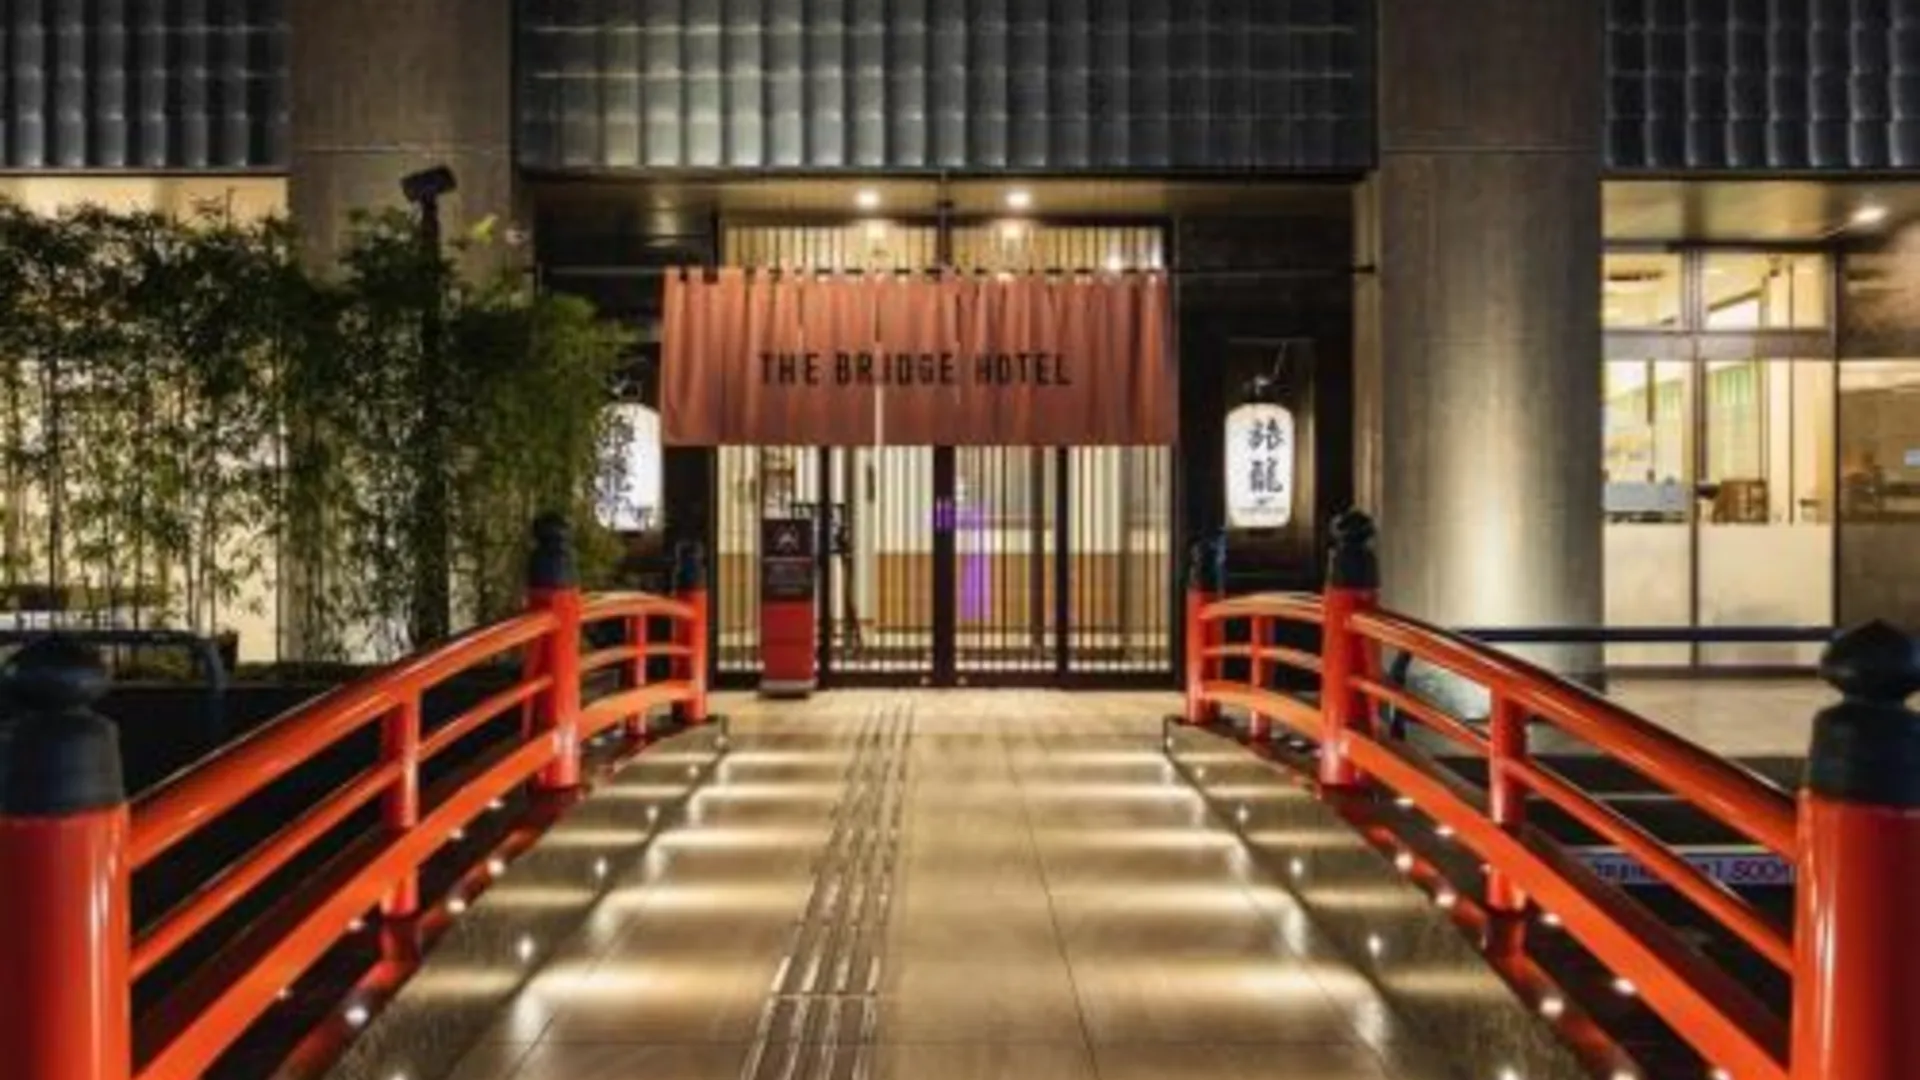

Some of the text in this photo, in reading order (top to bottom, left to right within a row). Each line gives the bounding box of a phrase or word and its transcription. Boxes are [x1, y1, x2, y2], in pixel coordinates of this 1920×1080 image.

[759, 352, 1073, 386] THE BRIDGE HOTEL
